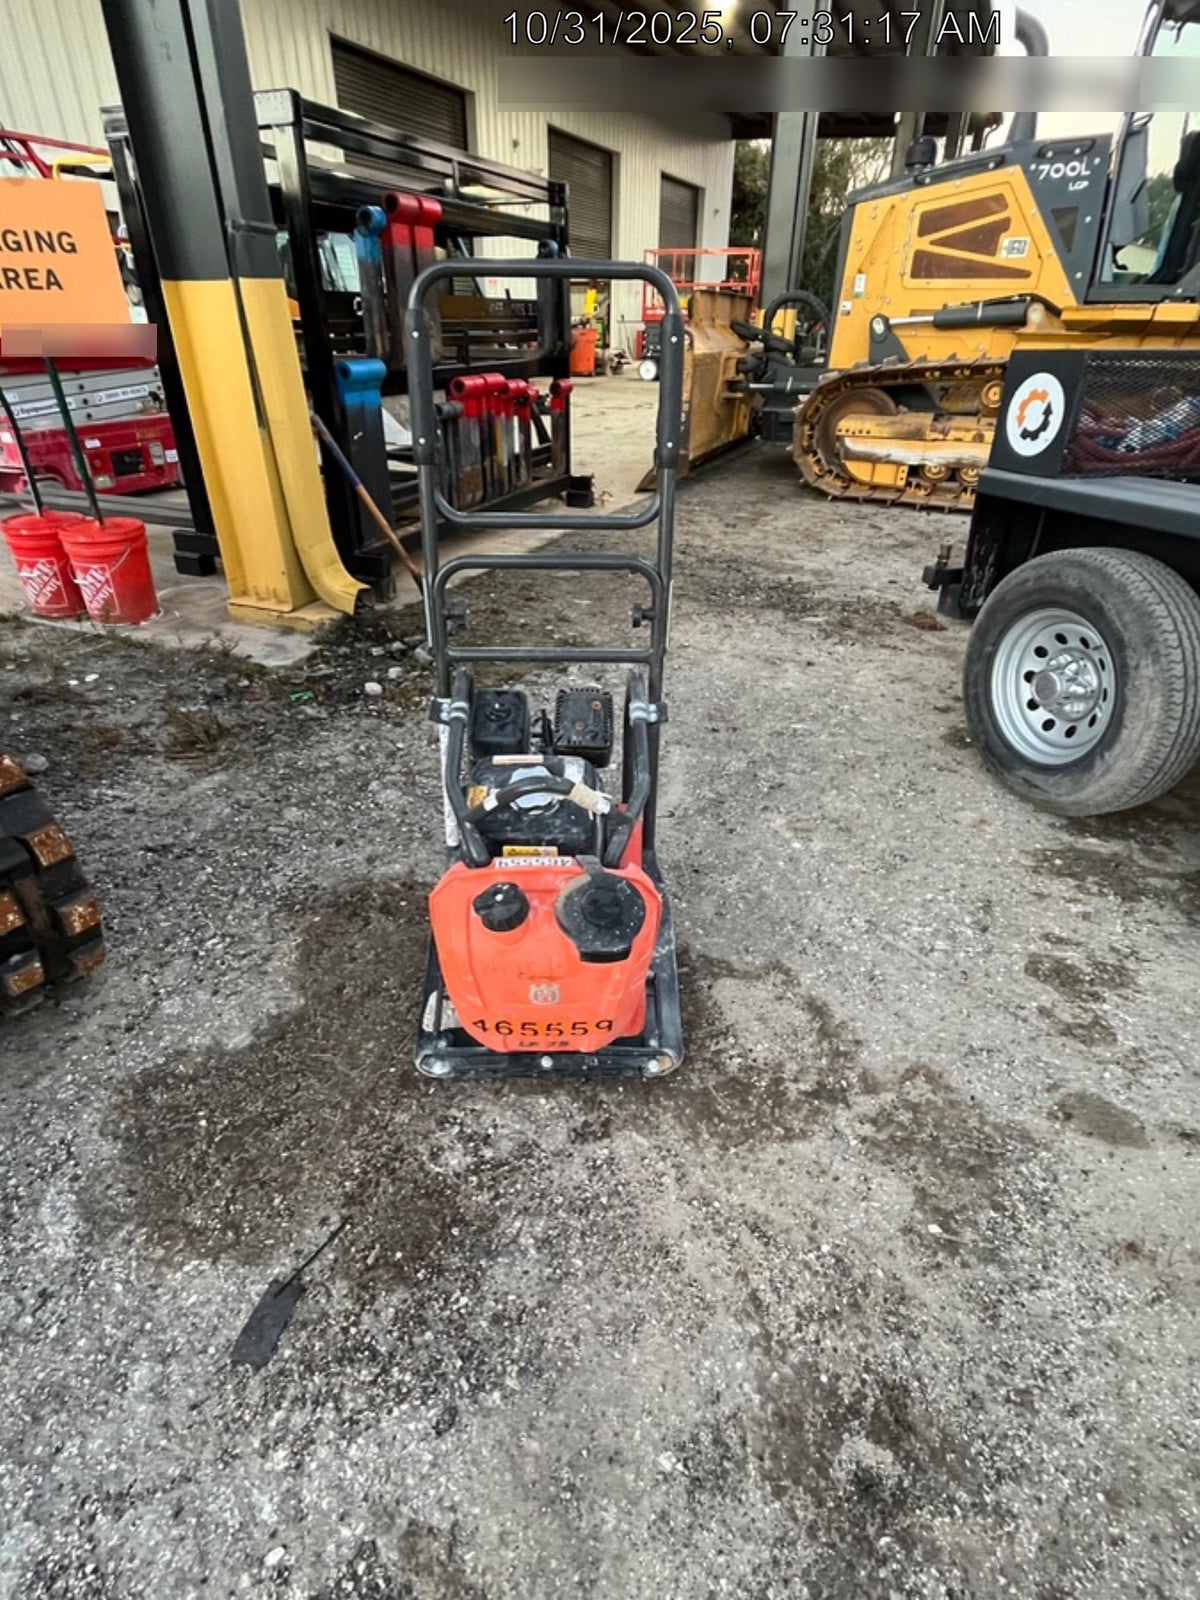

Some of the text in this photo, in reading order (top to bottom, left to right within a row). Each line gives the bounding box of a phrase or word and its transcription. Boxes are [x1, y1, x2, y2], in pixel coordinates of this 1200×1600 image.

[1038, 156, 1091, 180] 700L
[0, 229, 77, 254] GING
[0, 267, 64, 290] REA
[472, 1019, 613, 1037] 465559
